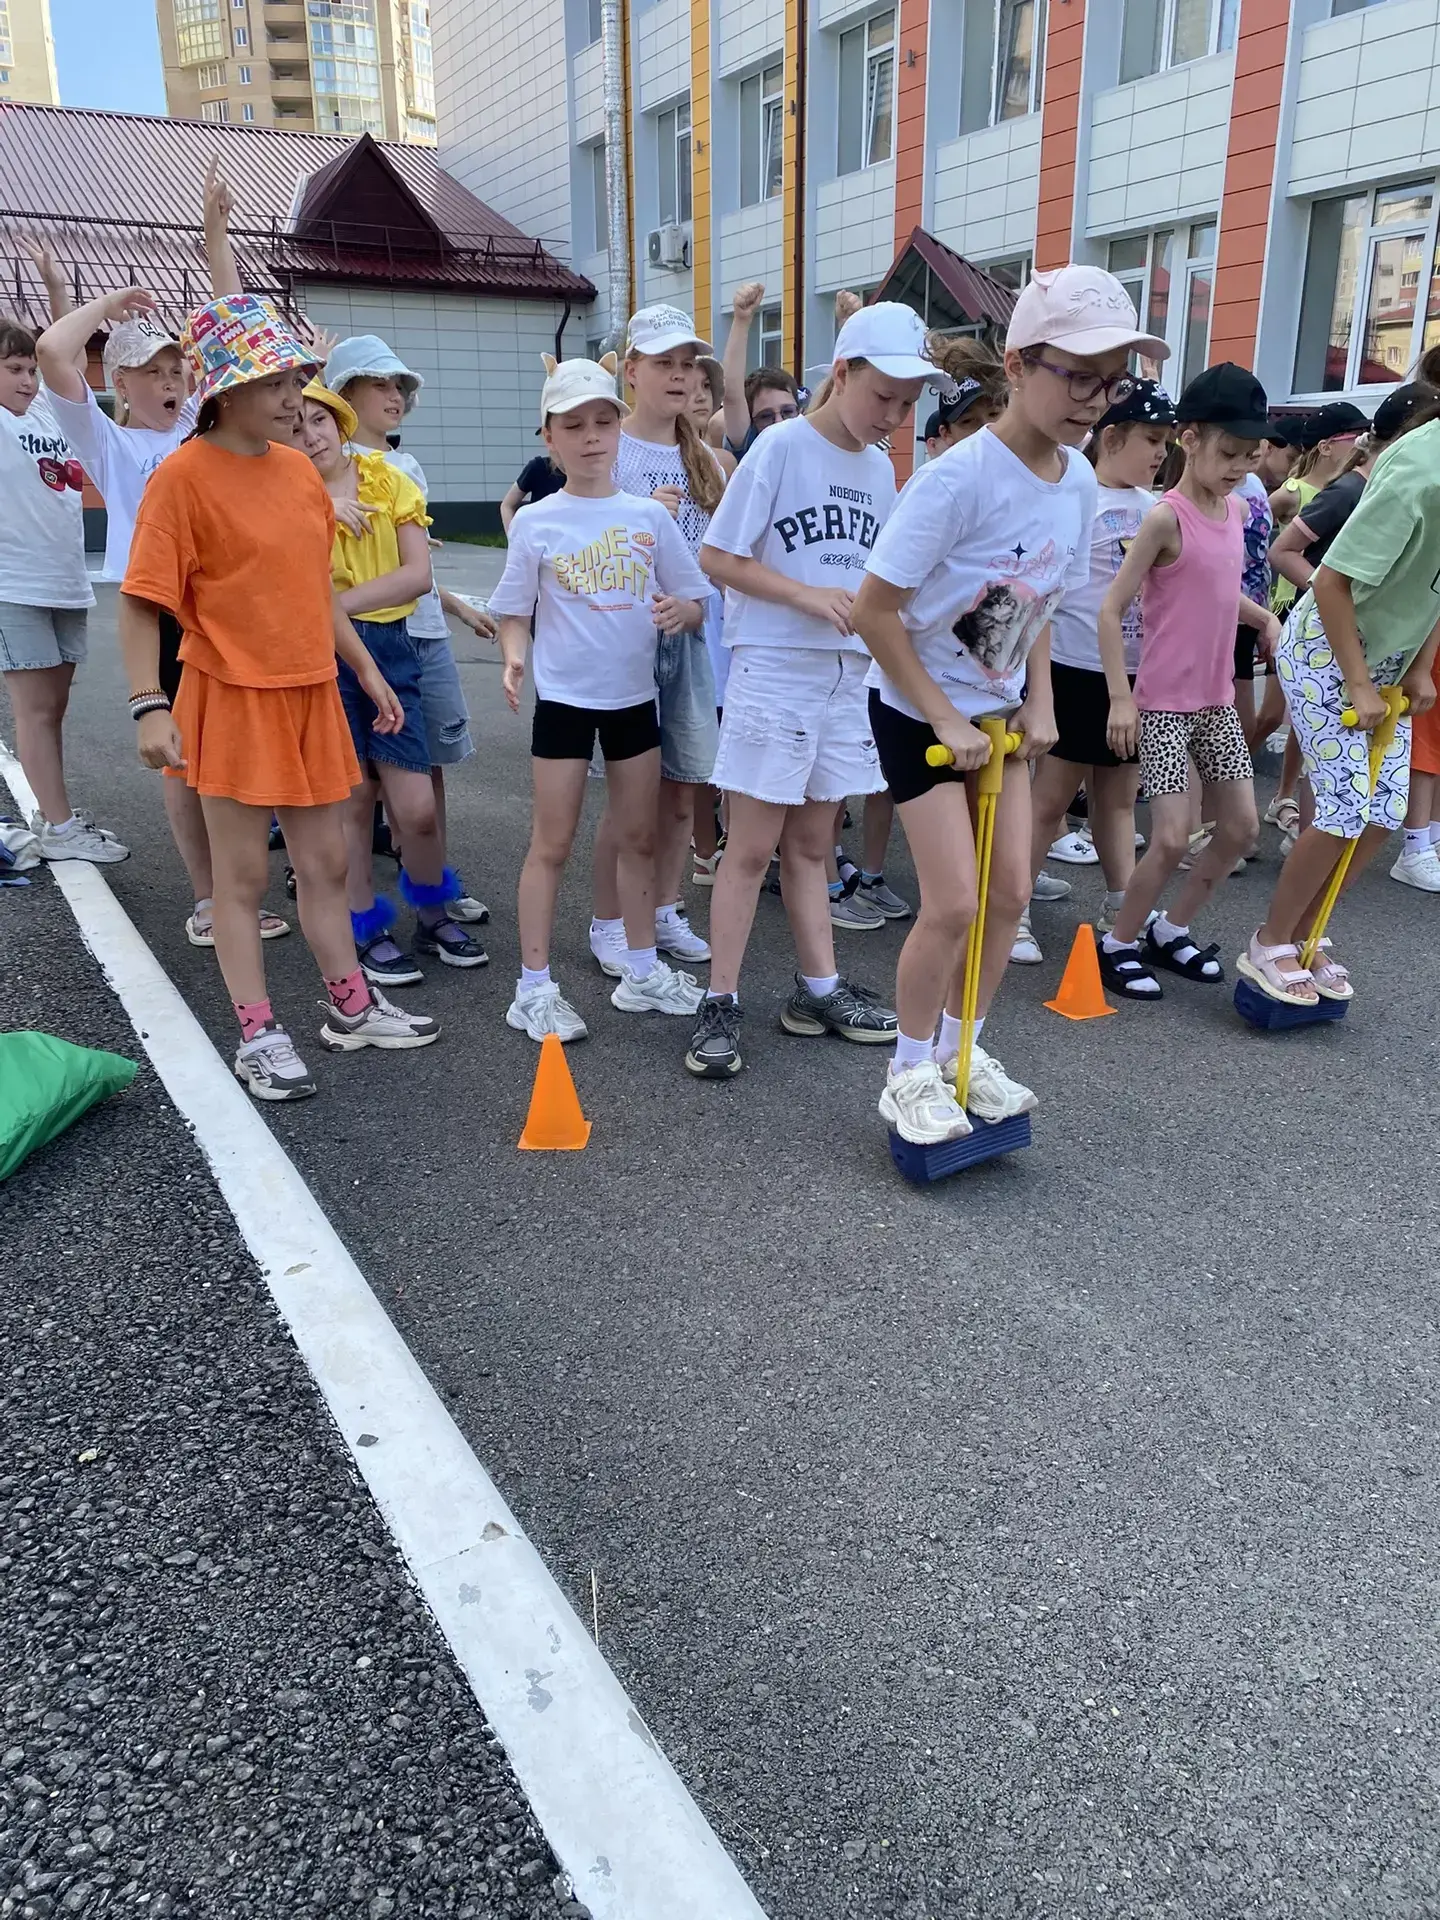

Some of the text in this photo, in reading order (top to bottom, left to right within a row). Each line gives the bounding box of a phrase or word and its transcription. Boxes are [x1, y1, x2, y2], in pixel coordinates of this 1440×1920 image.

[829, 484, 873, 506] NOBODY'S
[553, 526, 632, 575] SHINE
[556, 557, 650, 603] BRIGHT
